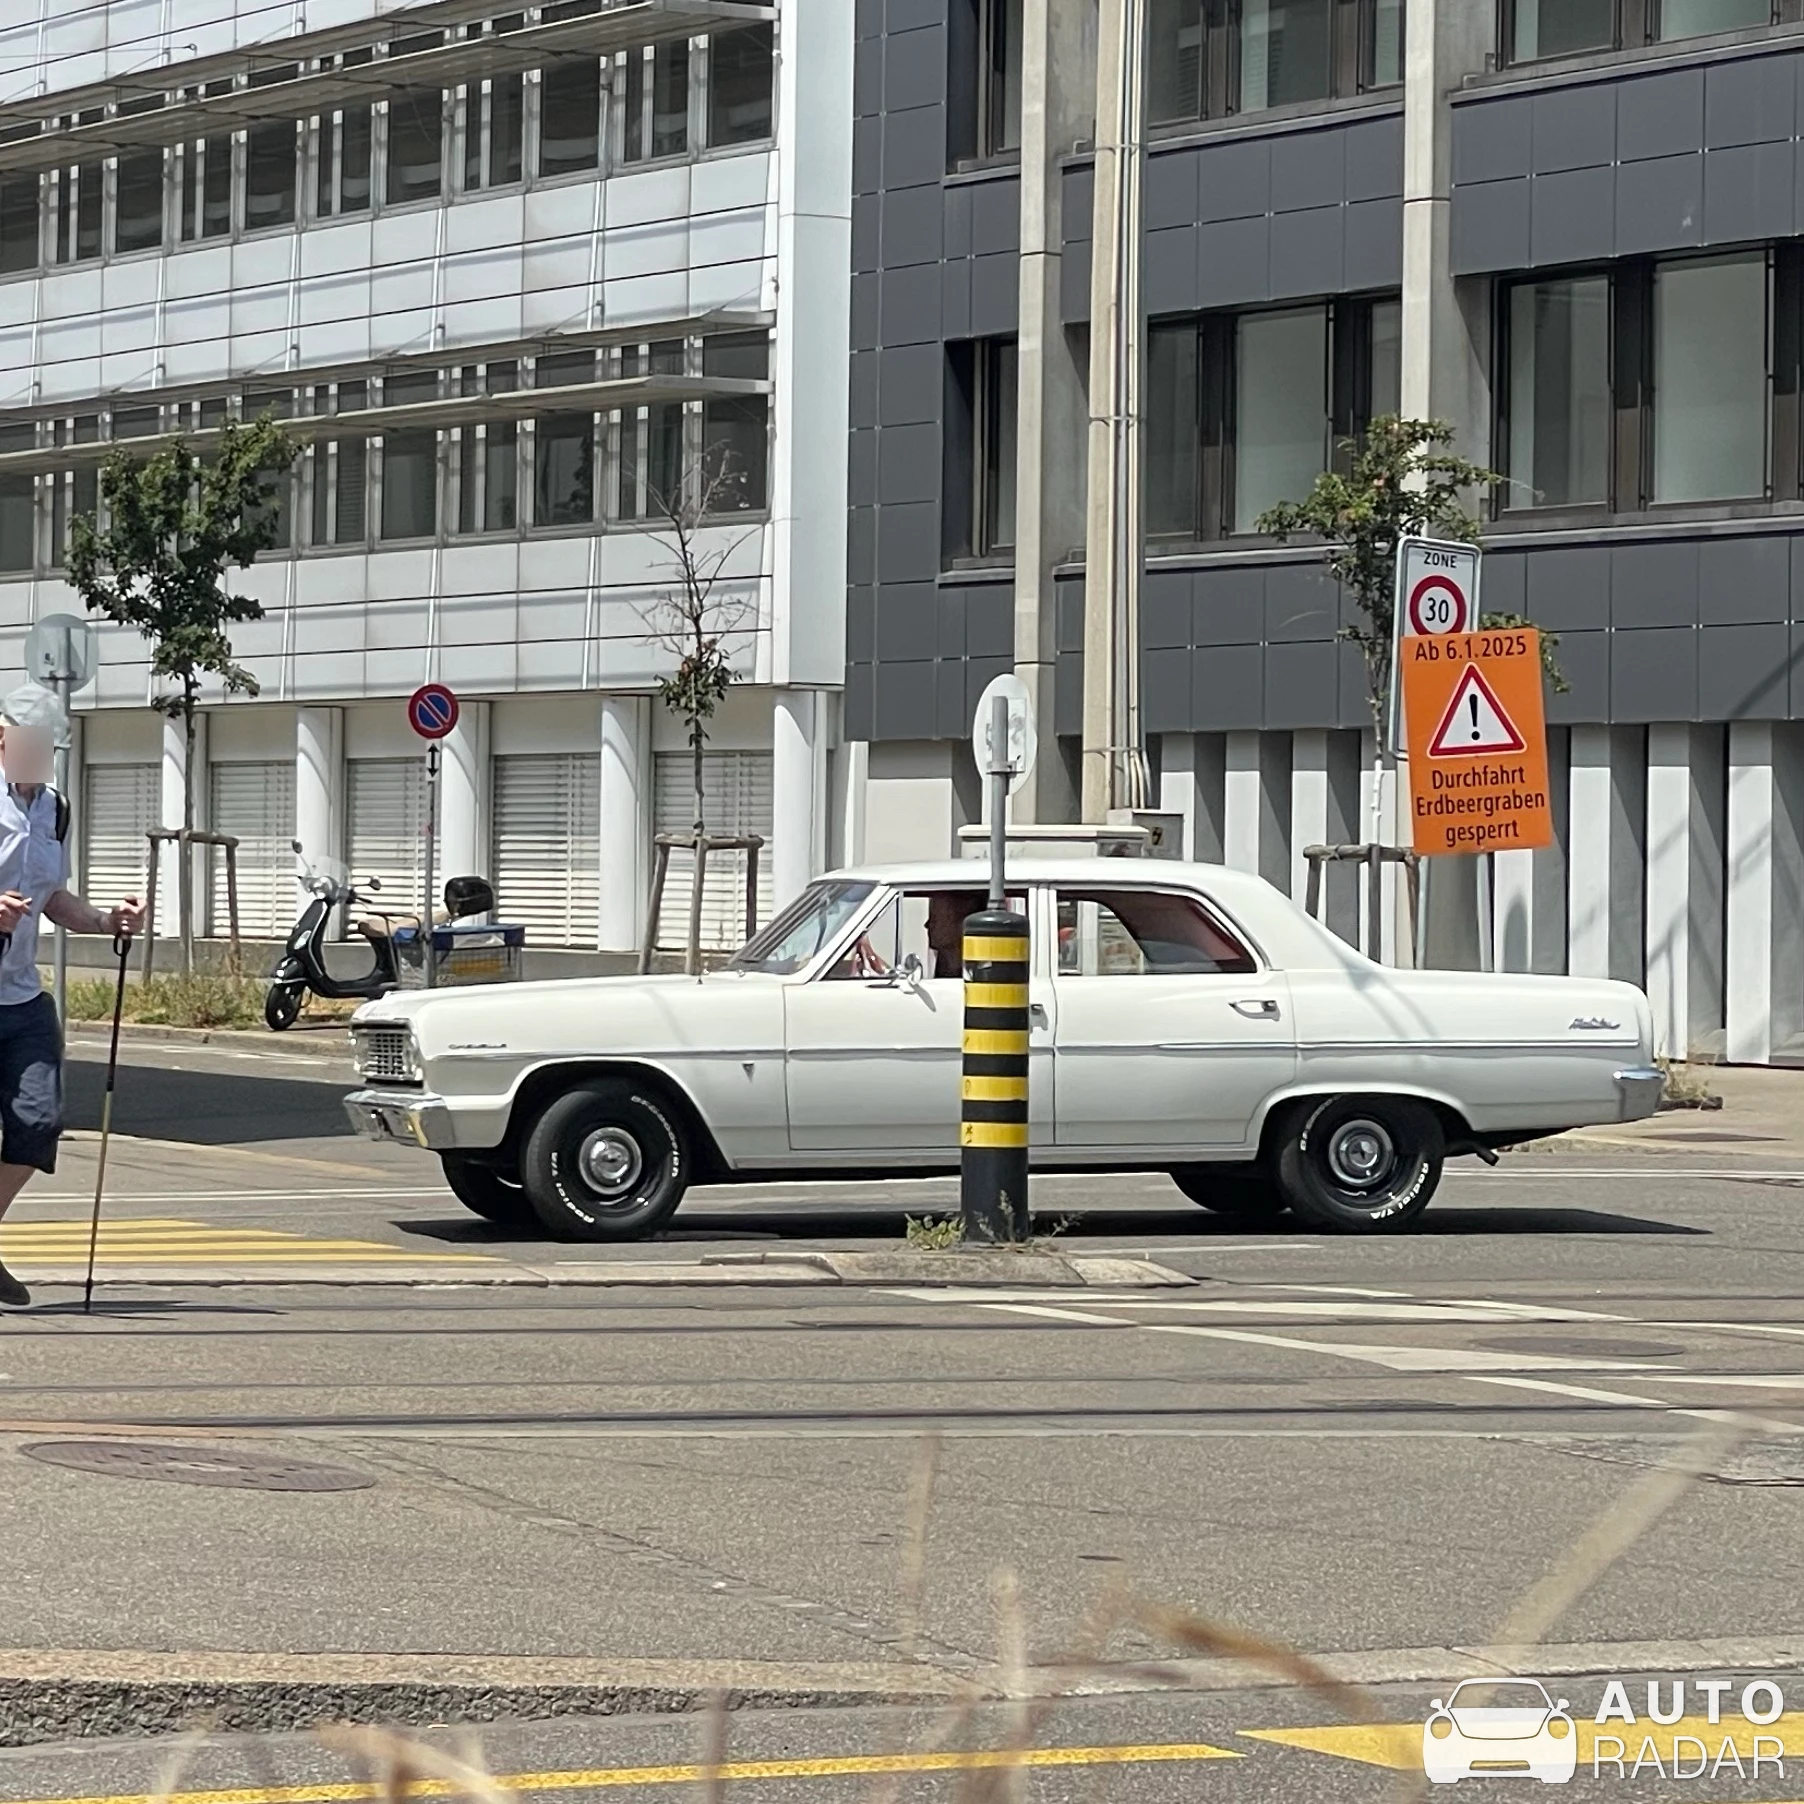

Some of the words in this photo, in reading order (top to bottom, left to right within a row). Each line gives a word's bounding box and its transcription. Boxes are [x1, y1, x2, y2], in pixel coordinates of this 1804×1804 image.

[1424, 551, 1457, 569] ZONE
[1425, 597, 1449, 624] 30
[1415, 640, 1439, 661] Ab
[1446, 635, 1527, 660] 6.1.2025
[1432, 765, 1526, 790] Durchfahrt
[1416, 790, 1545, 817] Erdbeergraben
[1446, 820, 1519, 847] gesperrt
